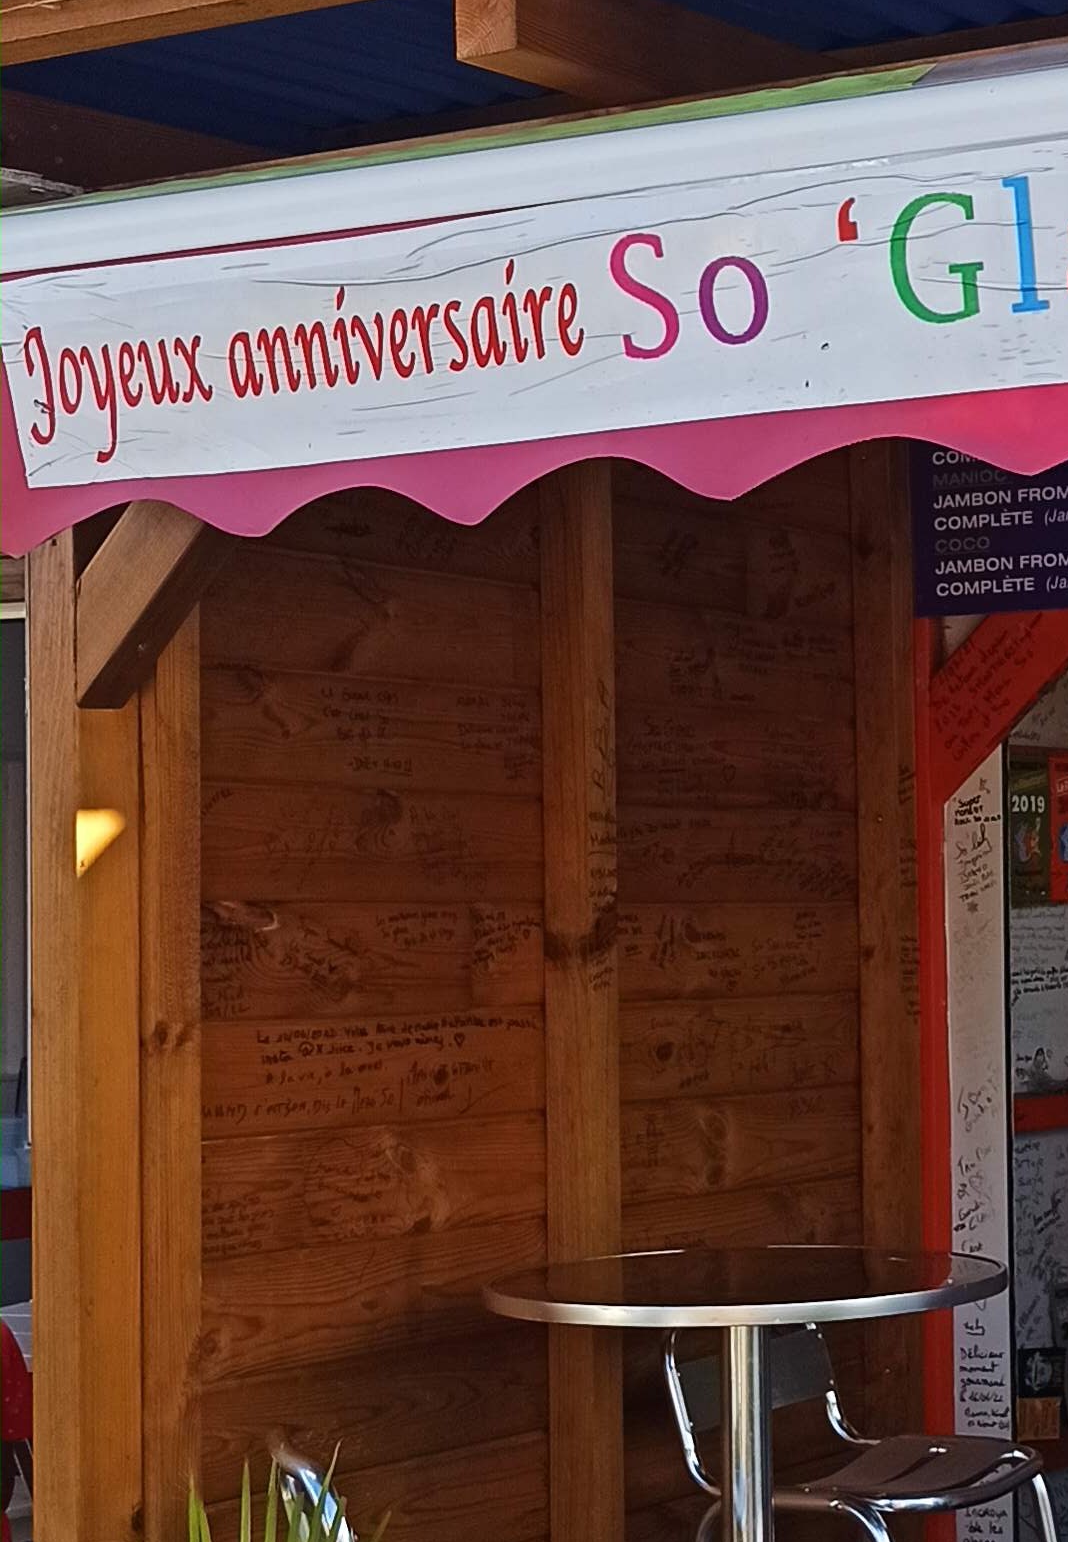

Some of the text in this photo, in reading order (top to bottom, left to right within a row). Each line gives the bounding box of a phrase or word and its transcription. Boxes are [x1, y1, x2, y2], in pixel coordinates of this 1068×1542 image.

[22, 325, 213, 464] Joyeux
[228, 258, 586, 401] anniversaire
[609, 233, 770, 361] So
[933, 490, 1012, 509] JAMBON
[933, 508, 1034, 531] COMPLÈTE
[935, 536, 991, 554] COCO
[935, 556, 1013, 575] JAMBON
[936, 575, 1035, 597] COMPLÈTE
[1011, 795, 1045, 814] 2019
